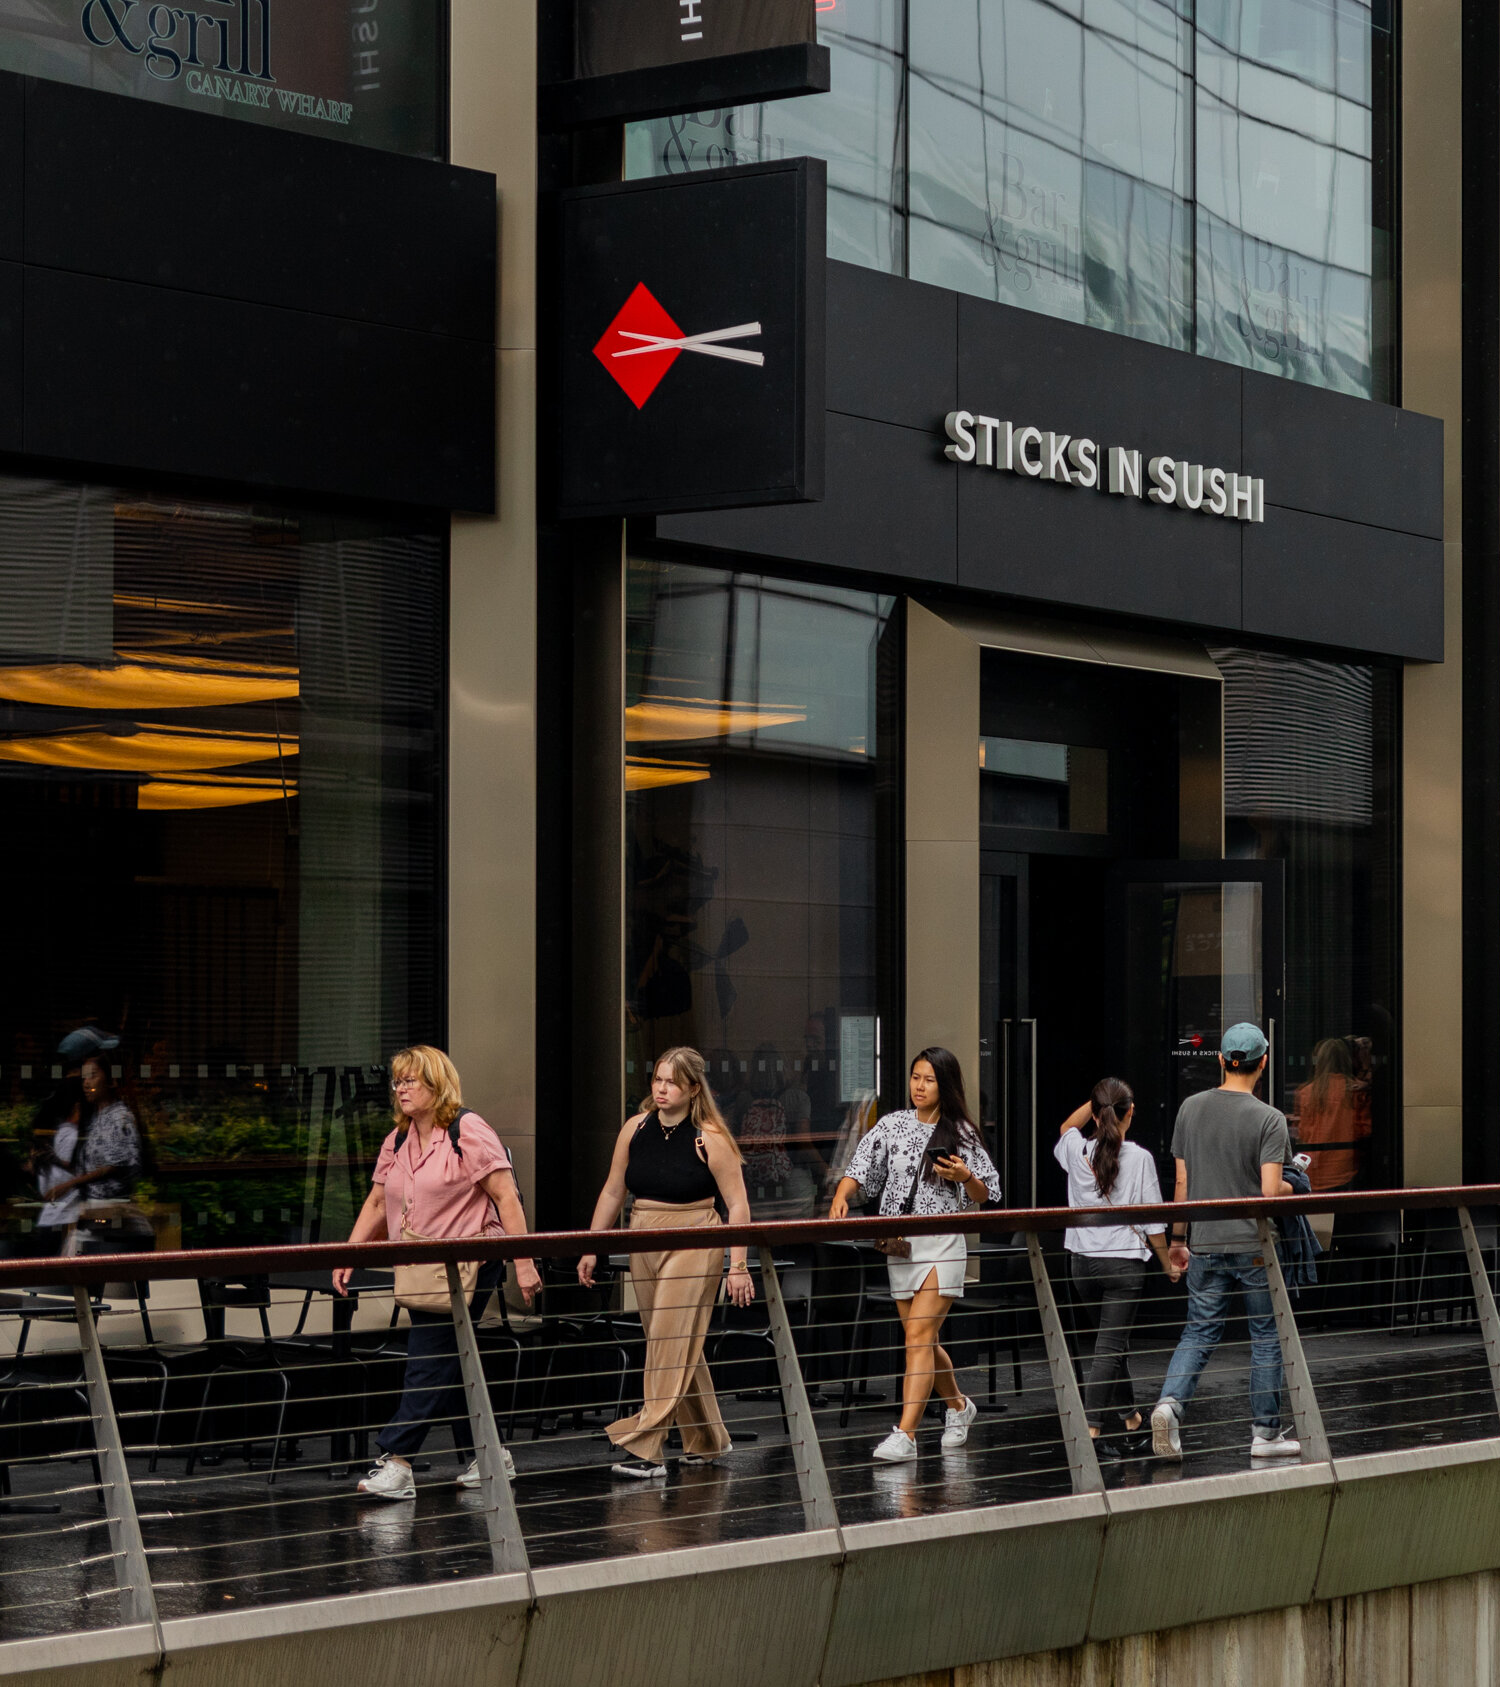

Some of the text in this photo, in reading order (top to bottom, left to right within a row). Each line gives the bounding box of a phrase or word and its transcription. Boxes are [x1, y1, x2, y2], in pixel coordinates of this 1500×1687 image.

[186, 70, 353, 125] CANARY WHARF
[944, 410, 1264, 522] STICKS N SUSHI
